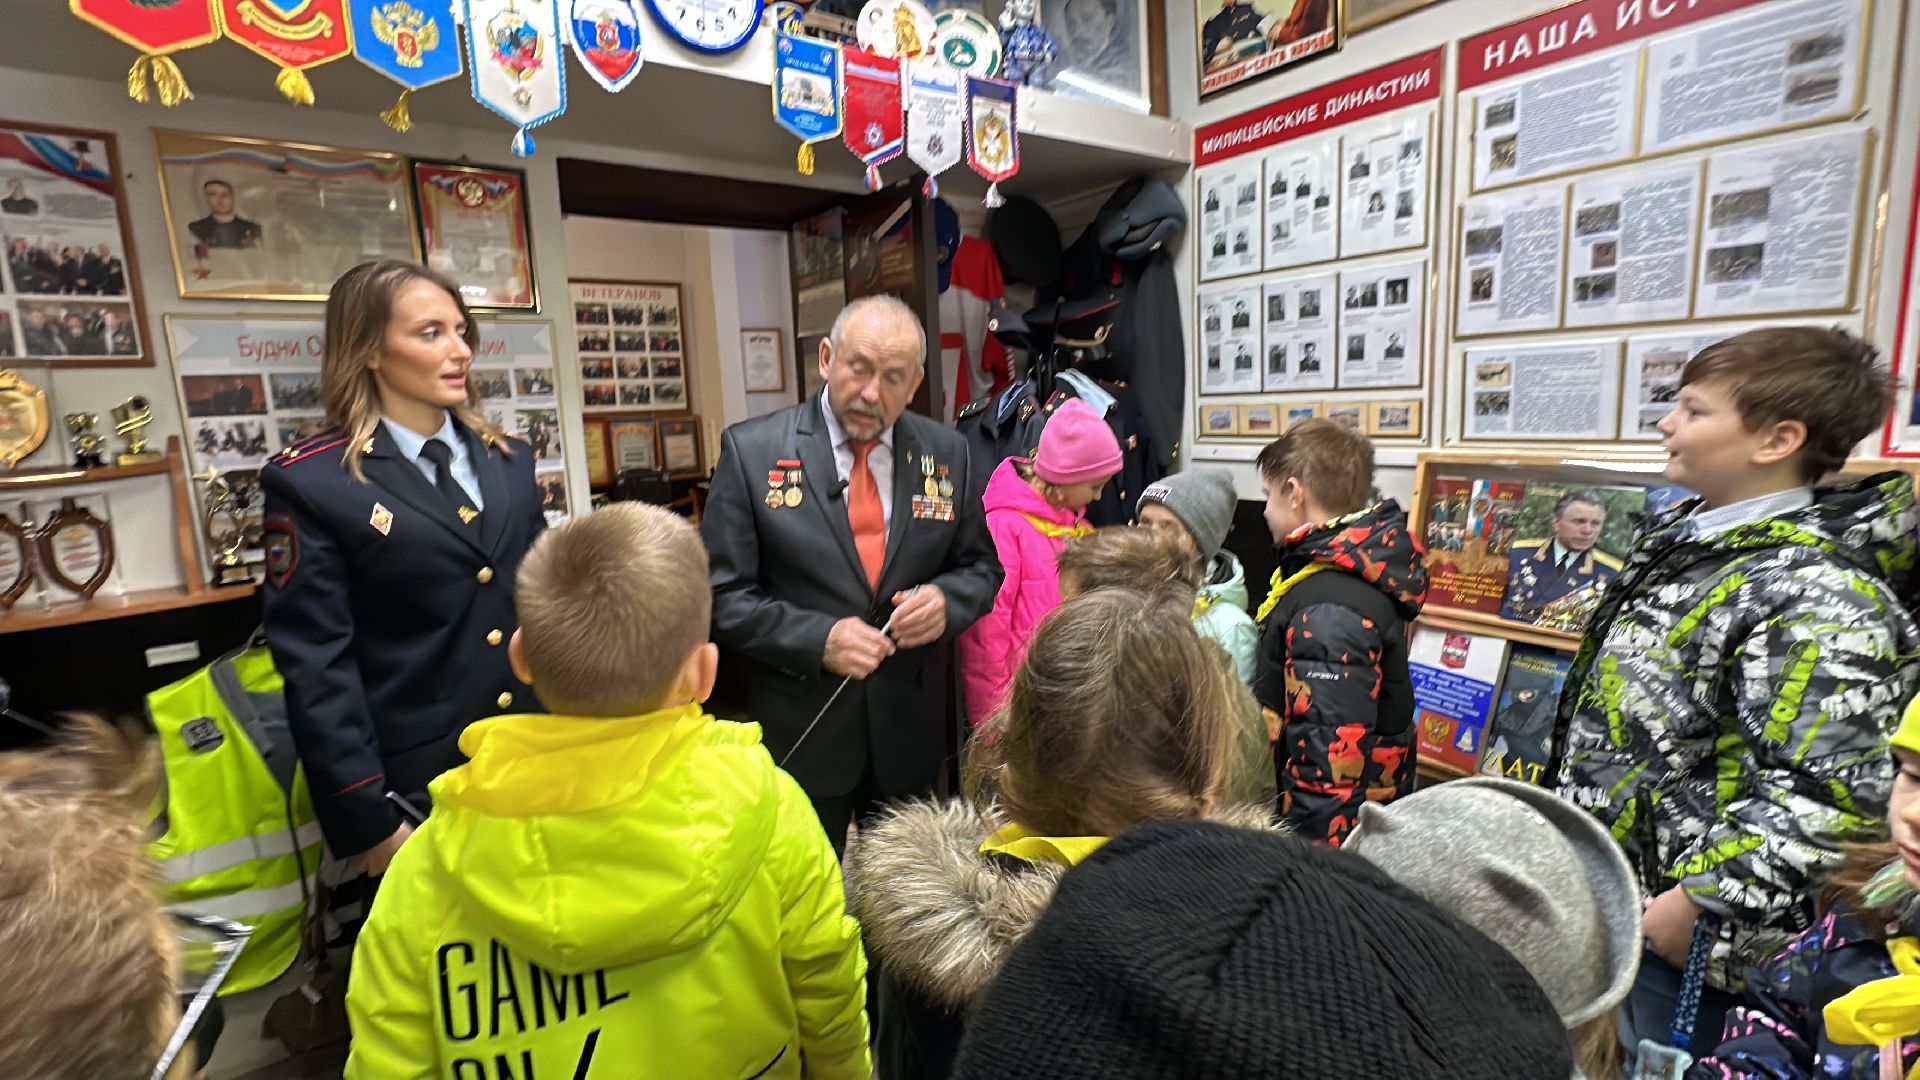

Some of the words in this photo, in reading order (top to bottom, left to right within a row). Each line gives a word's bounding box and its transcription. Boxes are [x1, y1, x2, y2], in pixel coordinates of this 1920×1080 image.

[1484, 13, 1598, 71] НАША
[1615, 0, 1698, 31] ИС
[1202, 105, 1318, 156] МИЛИЦЕЙСКИЕ
[1324, 67, 1432, 120] ДИНАСТИИ
[582, 286, 663, 301] ВЕТЕРАНОВ
[236, 335, 301, 362] Будни
